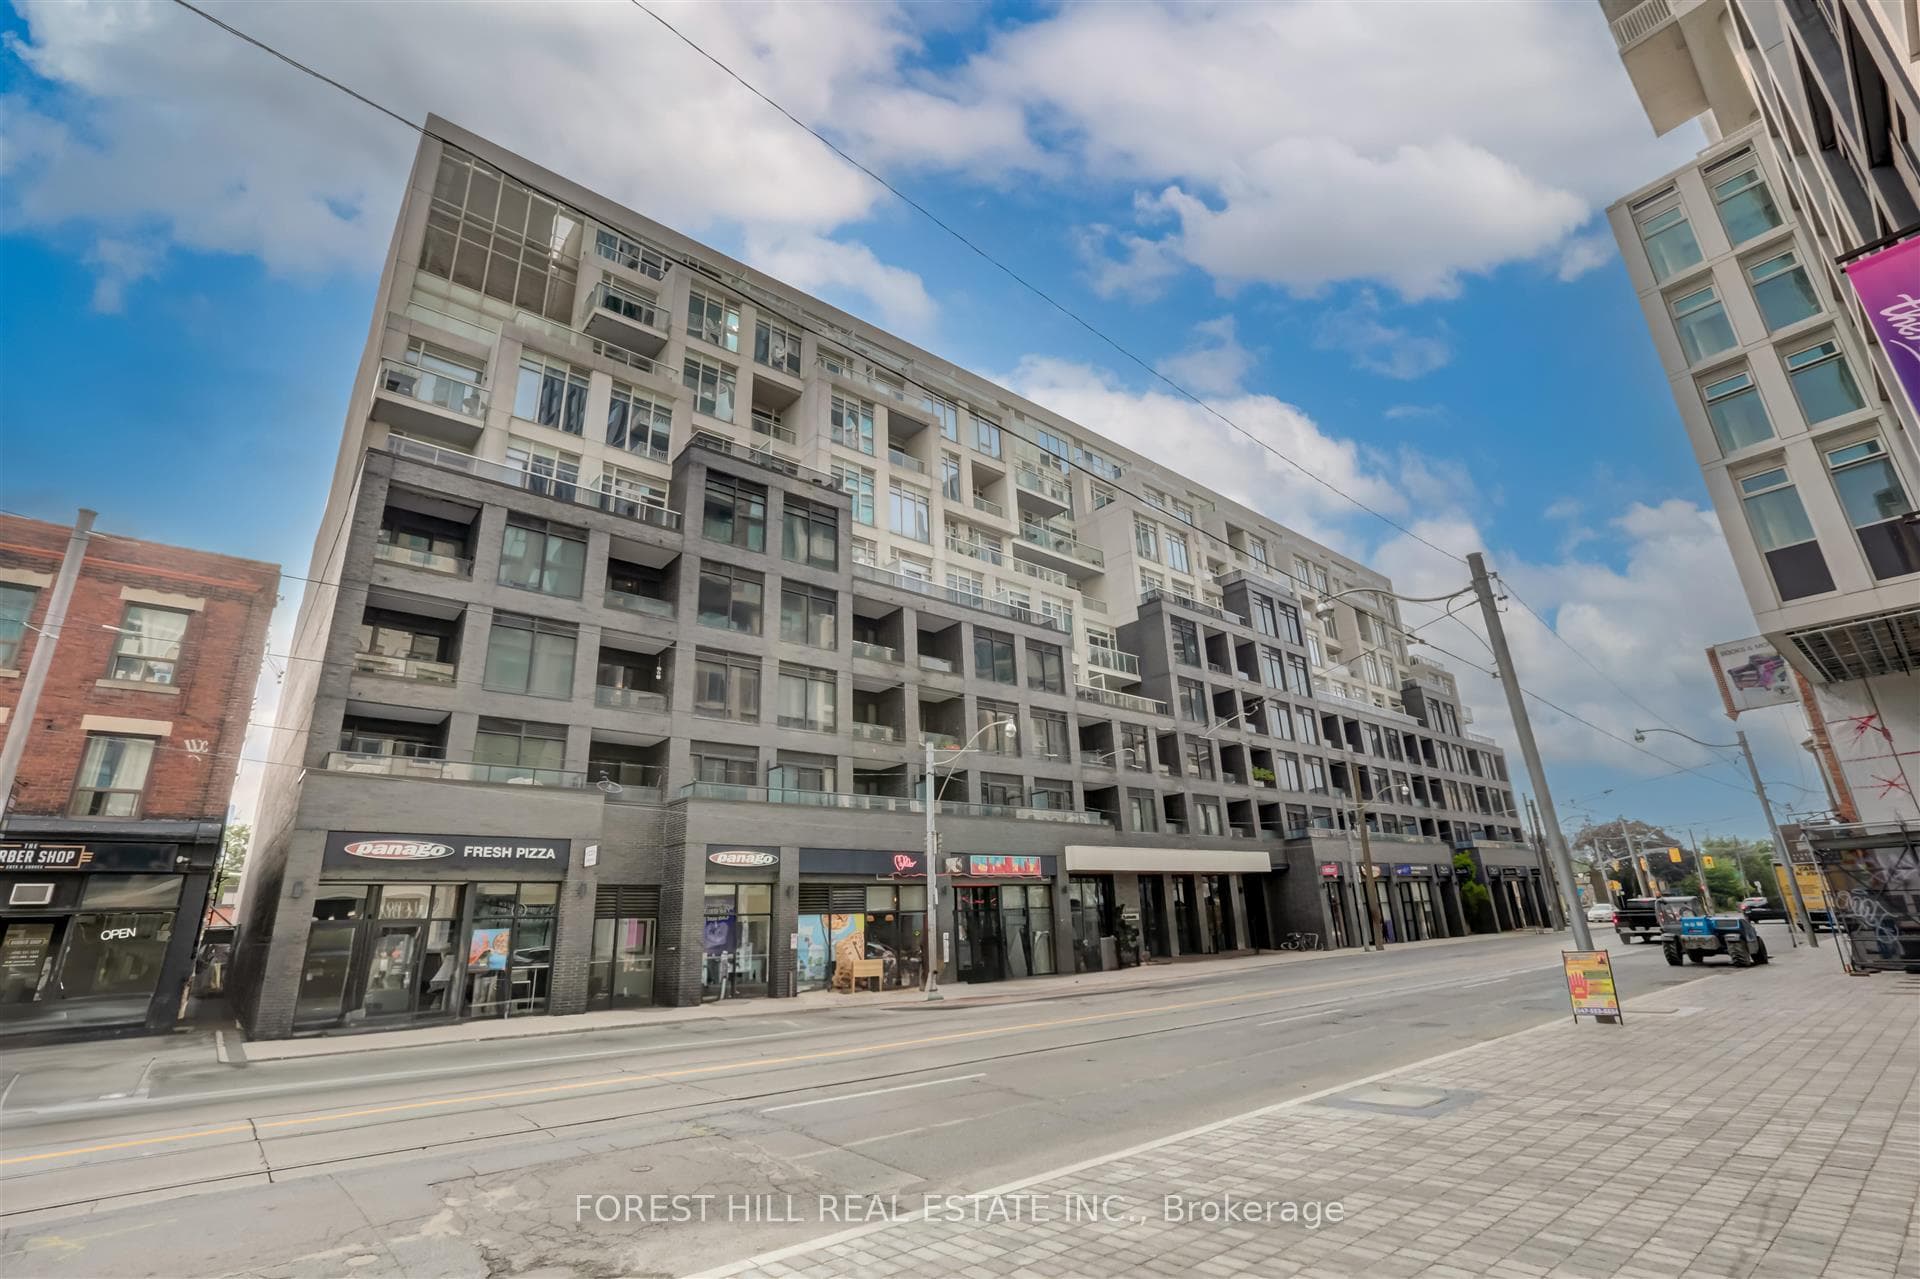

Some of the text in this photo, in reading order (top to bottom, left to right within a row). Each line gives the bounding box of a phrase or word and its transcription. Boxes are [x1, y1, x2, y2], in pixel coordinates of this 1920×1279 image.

[37, 850, 75, 863] SHOP
[356, 842, 556, 859] panago FRESH PIZZA
[717, 852, 773, 865] panago
[100, 927, 136, 941] OPEN
